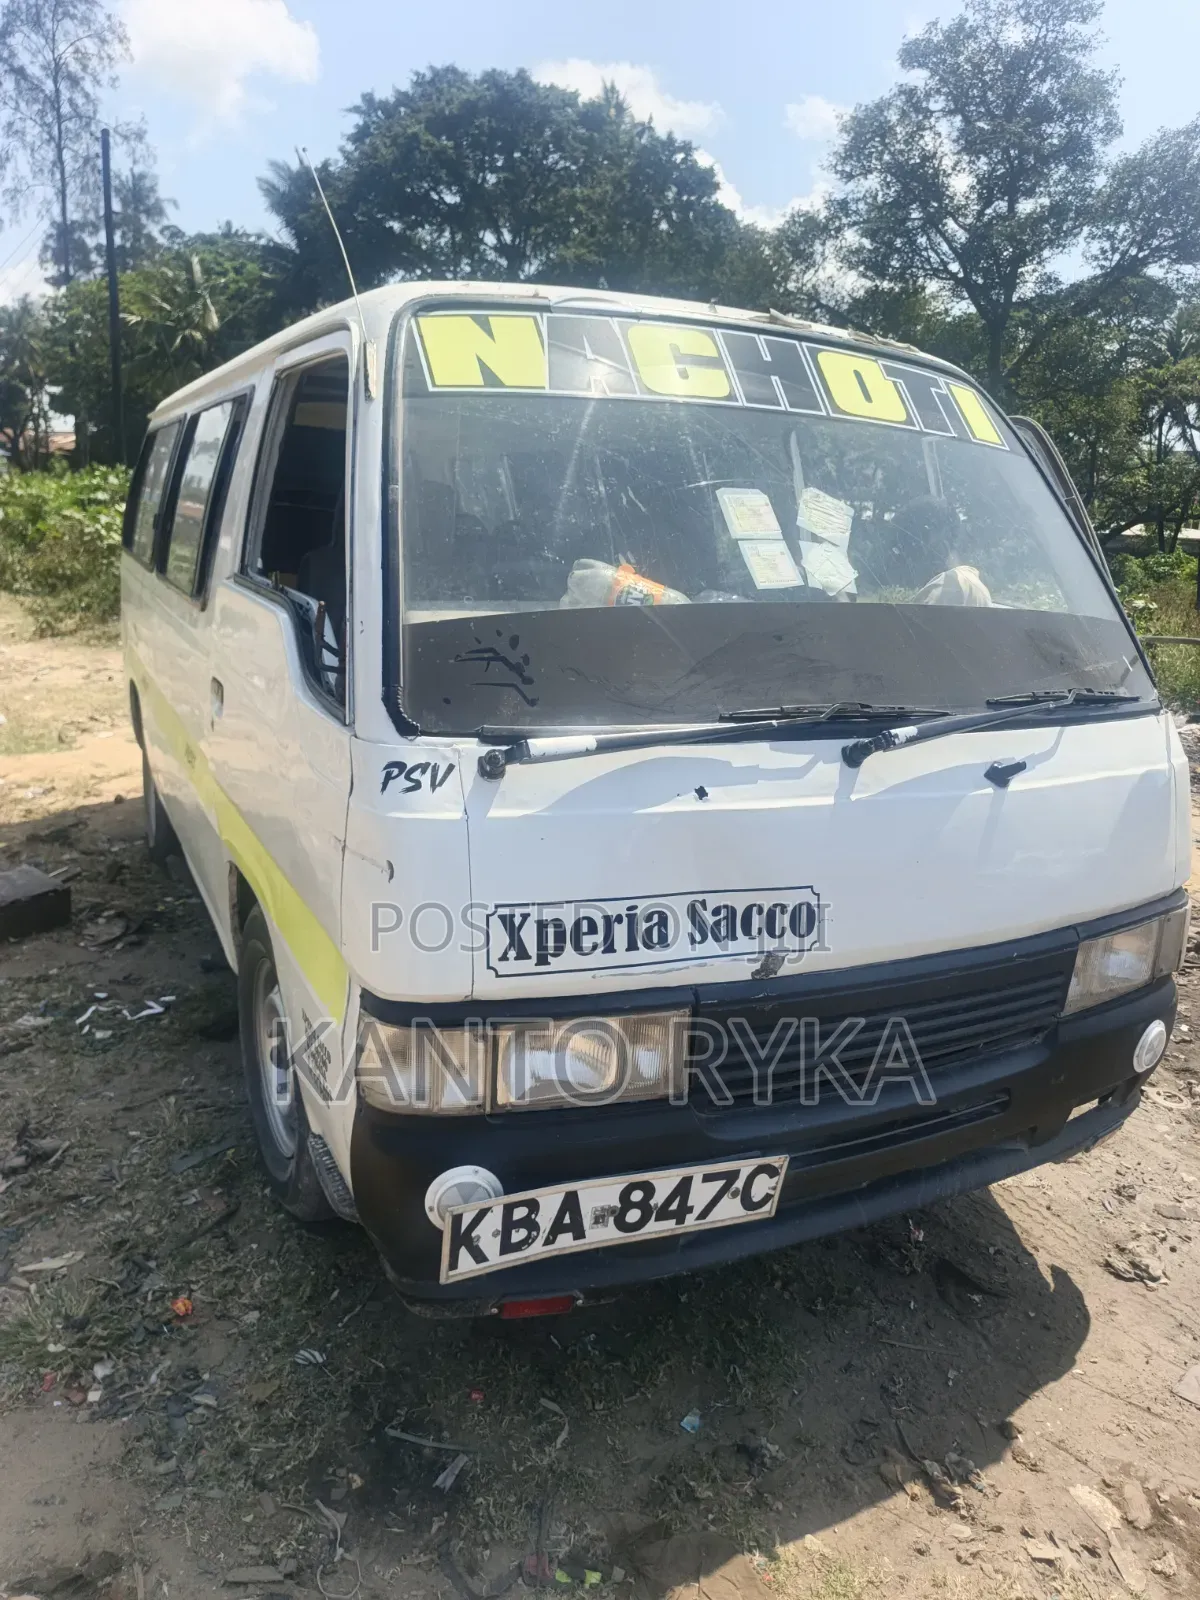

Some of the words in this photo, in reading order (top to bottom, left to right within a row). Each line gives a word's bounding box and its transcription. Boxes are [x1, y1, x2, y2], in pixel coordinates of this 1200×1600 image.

[413, 312, 1009, 450] NACHOTI
[380, 761, 457, 796] PSV
[496, 904, 670, 966] Xperia
[686, 898, 817, 946] Sacco
[447, 1204, 588, 1274] KBA
[612, 1162, 782, 1234] 847C
